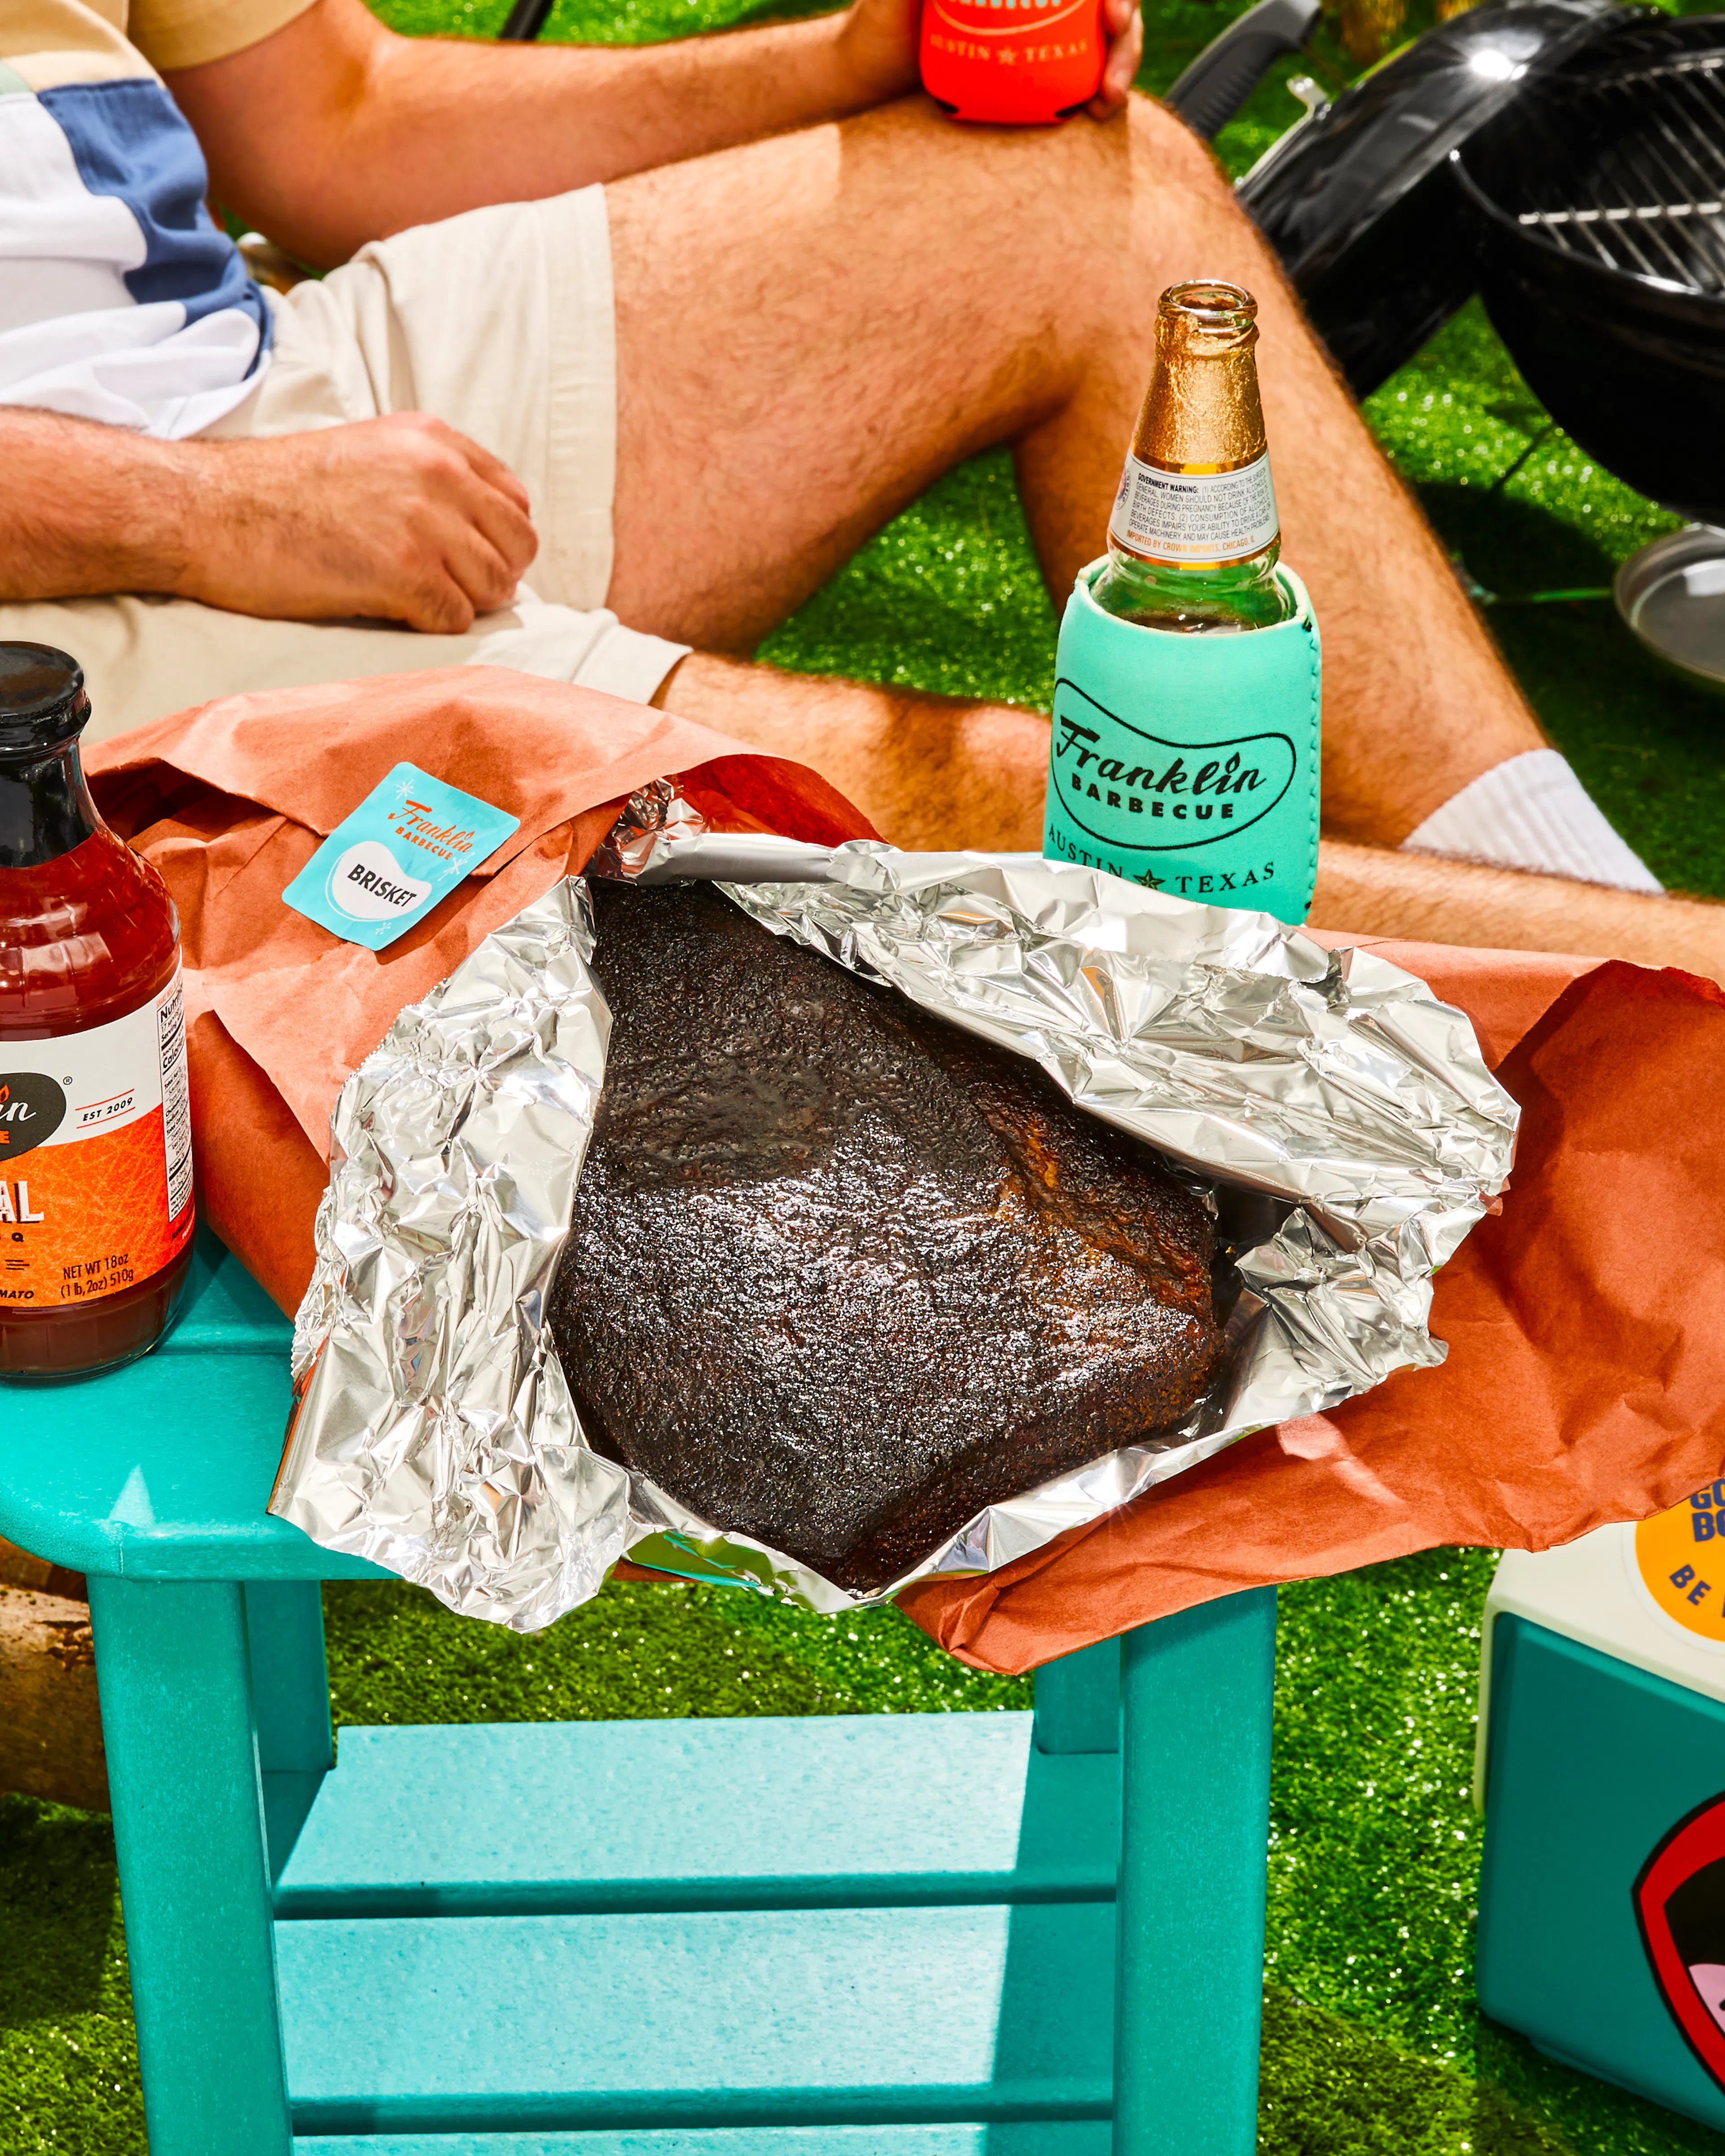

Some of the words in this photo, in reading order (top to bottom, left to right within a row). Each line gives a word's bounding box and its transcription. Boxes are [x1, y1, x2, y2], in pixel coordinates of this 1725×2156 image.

[1138, 473, 1168, 490] GOVERNMENT
[1170, 484, 1199, 493] WARNING:
[1211, 481, 1238, 493] ACCORDING
[1239, 479, 1245, 487] TO
[1135, 491, 1159, 507] BEVERAGES
[1160, 501, 1181, 511] DURING
[1182, 504, 1217, 512] PREGNANCY
[1218, 499, 1242, 511] BECAUSE
[1243, 497, 1249, 505] OF
[1161, 491, 1183, 502] WOMEN
[1185, 495, 1212, 503] SHOULD
[1214, 493, 1226, 502] NOT
[1228, 489, 1245, 499] DRINK
[1131, 509, 1160, 527] BEVERAGES
[1162, 521, 1185, 531] IMPAIRS
[1187, 523, 1205, 531] YOUR
[1208, 520, 1230, 531] ABILITY
[1232, 519, 1239, 527] TO
[1240, 513, 1255, 525] DRIVE
[1132, 500, 1146, 512] BIRTH
[1179, 514, 1188, 523] (2)
[1190, 510, 1238, 522] CONSUMPTION
[1240, 507, 1247, 516] OF
[1127, 530, 1151, 546] IMPORTED
[1153, 539, 1161, 548] BY
[1163, 543, 1187, 552] CROWN
[1128, 518, 1148, 533] OPERATE
[1183, 533, 1195, 541] AND
[1197, 532, 1209, 540] MAY
[1211, 530, 1230, 540] CAUSE
[1231, 525, 1251, 537] HEALTH
[1057, 715, 1266, 795] Franklin
[1072, 773, 1234, 819] BARBECUE
[388, 800, 475, 853] Franklin
[395, 826, 453, 860] BARBECUE
[1049, 823, 1122, 878] AUSTIN
[1176, 862, 1274, 893] TEXAS
[347, 864, 417, 907] BRISKET
[83, 1109, 102, 1121] EST
[106, 1097, 133, 1114] 2009
[63, 1264, 82, 1280] NET
[85, 1260, 101, 1275] WT
[105, 1254, 128, 1270] 18oz
[110, 1268, 133, 1286] 510g
[0, 1290, 34, 1299] MATO
